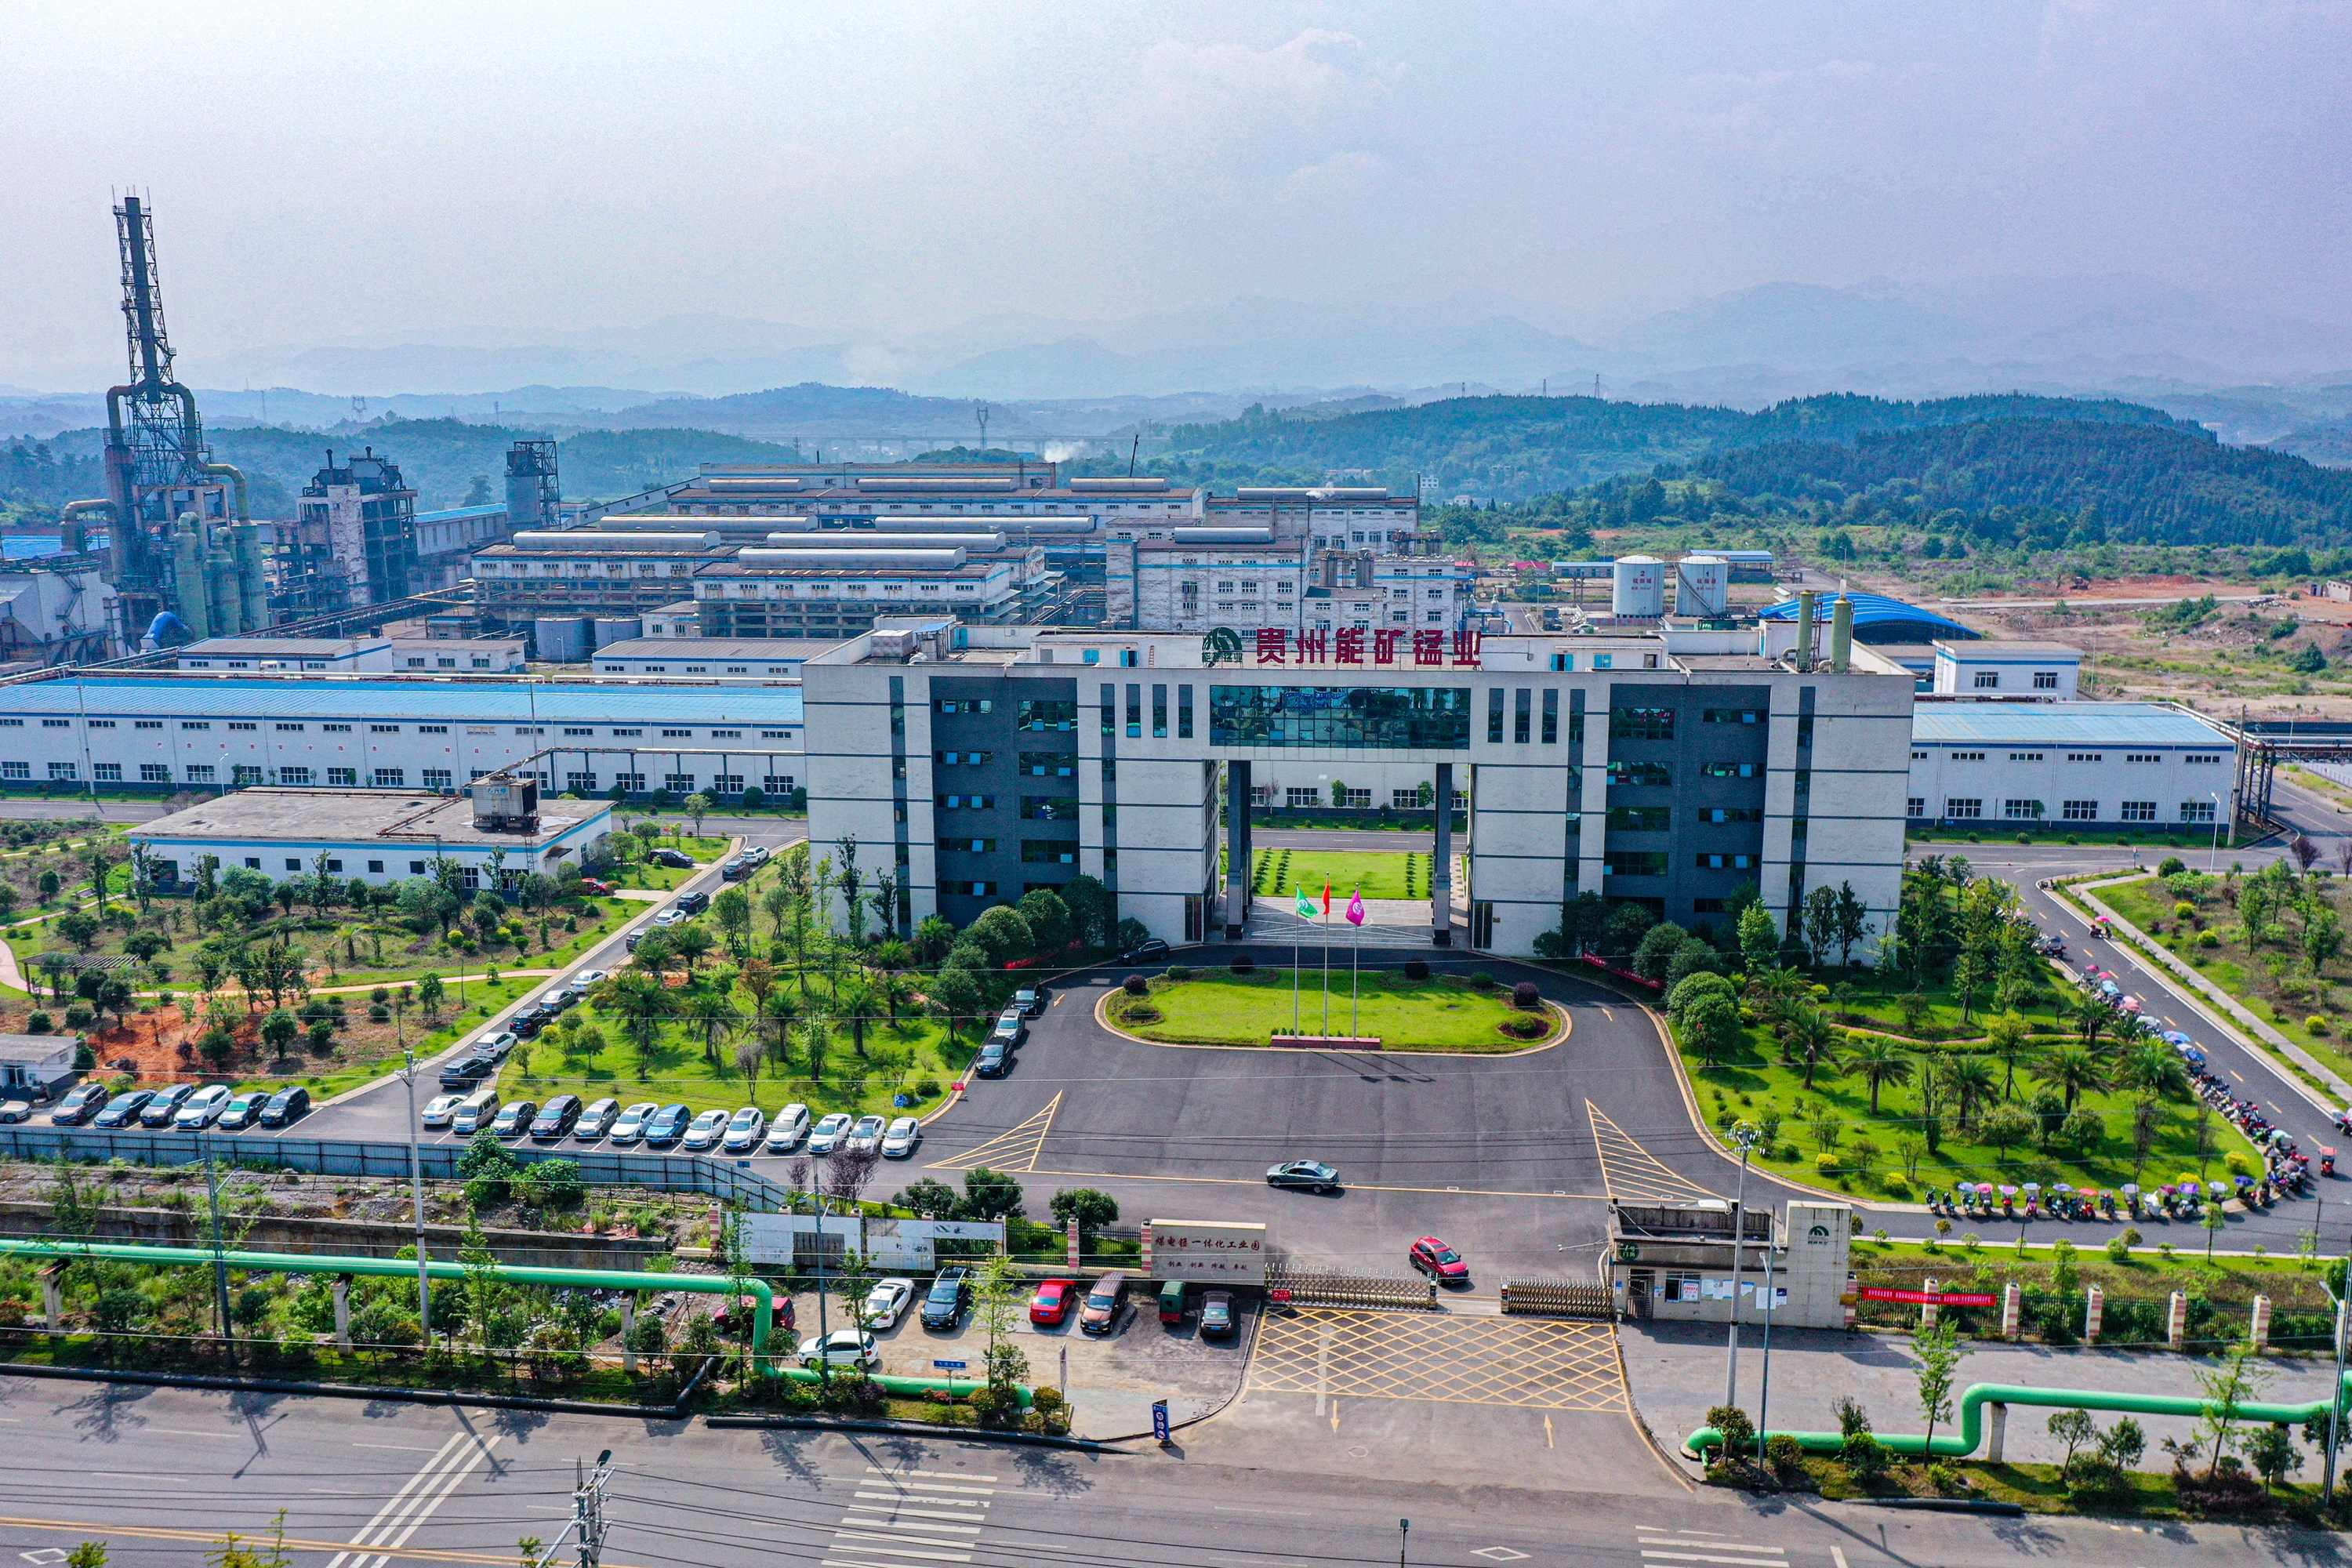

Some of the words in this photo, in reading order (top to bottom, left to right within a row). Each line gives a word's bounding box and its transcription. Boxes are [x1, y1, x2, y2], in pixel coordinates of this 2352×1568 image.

[1256, 627, 1482, 666] 贵州能矿锰业
[1155, 1236, 1260, 1250] 煤电锰一体化工业园
